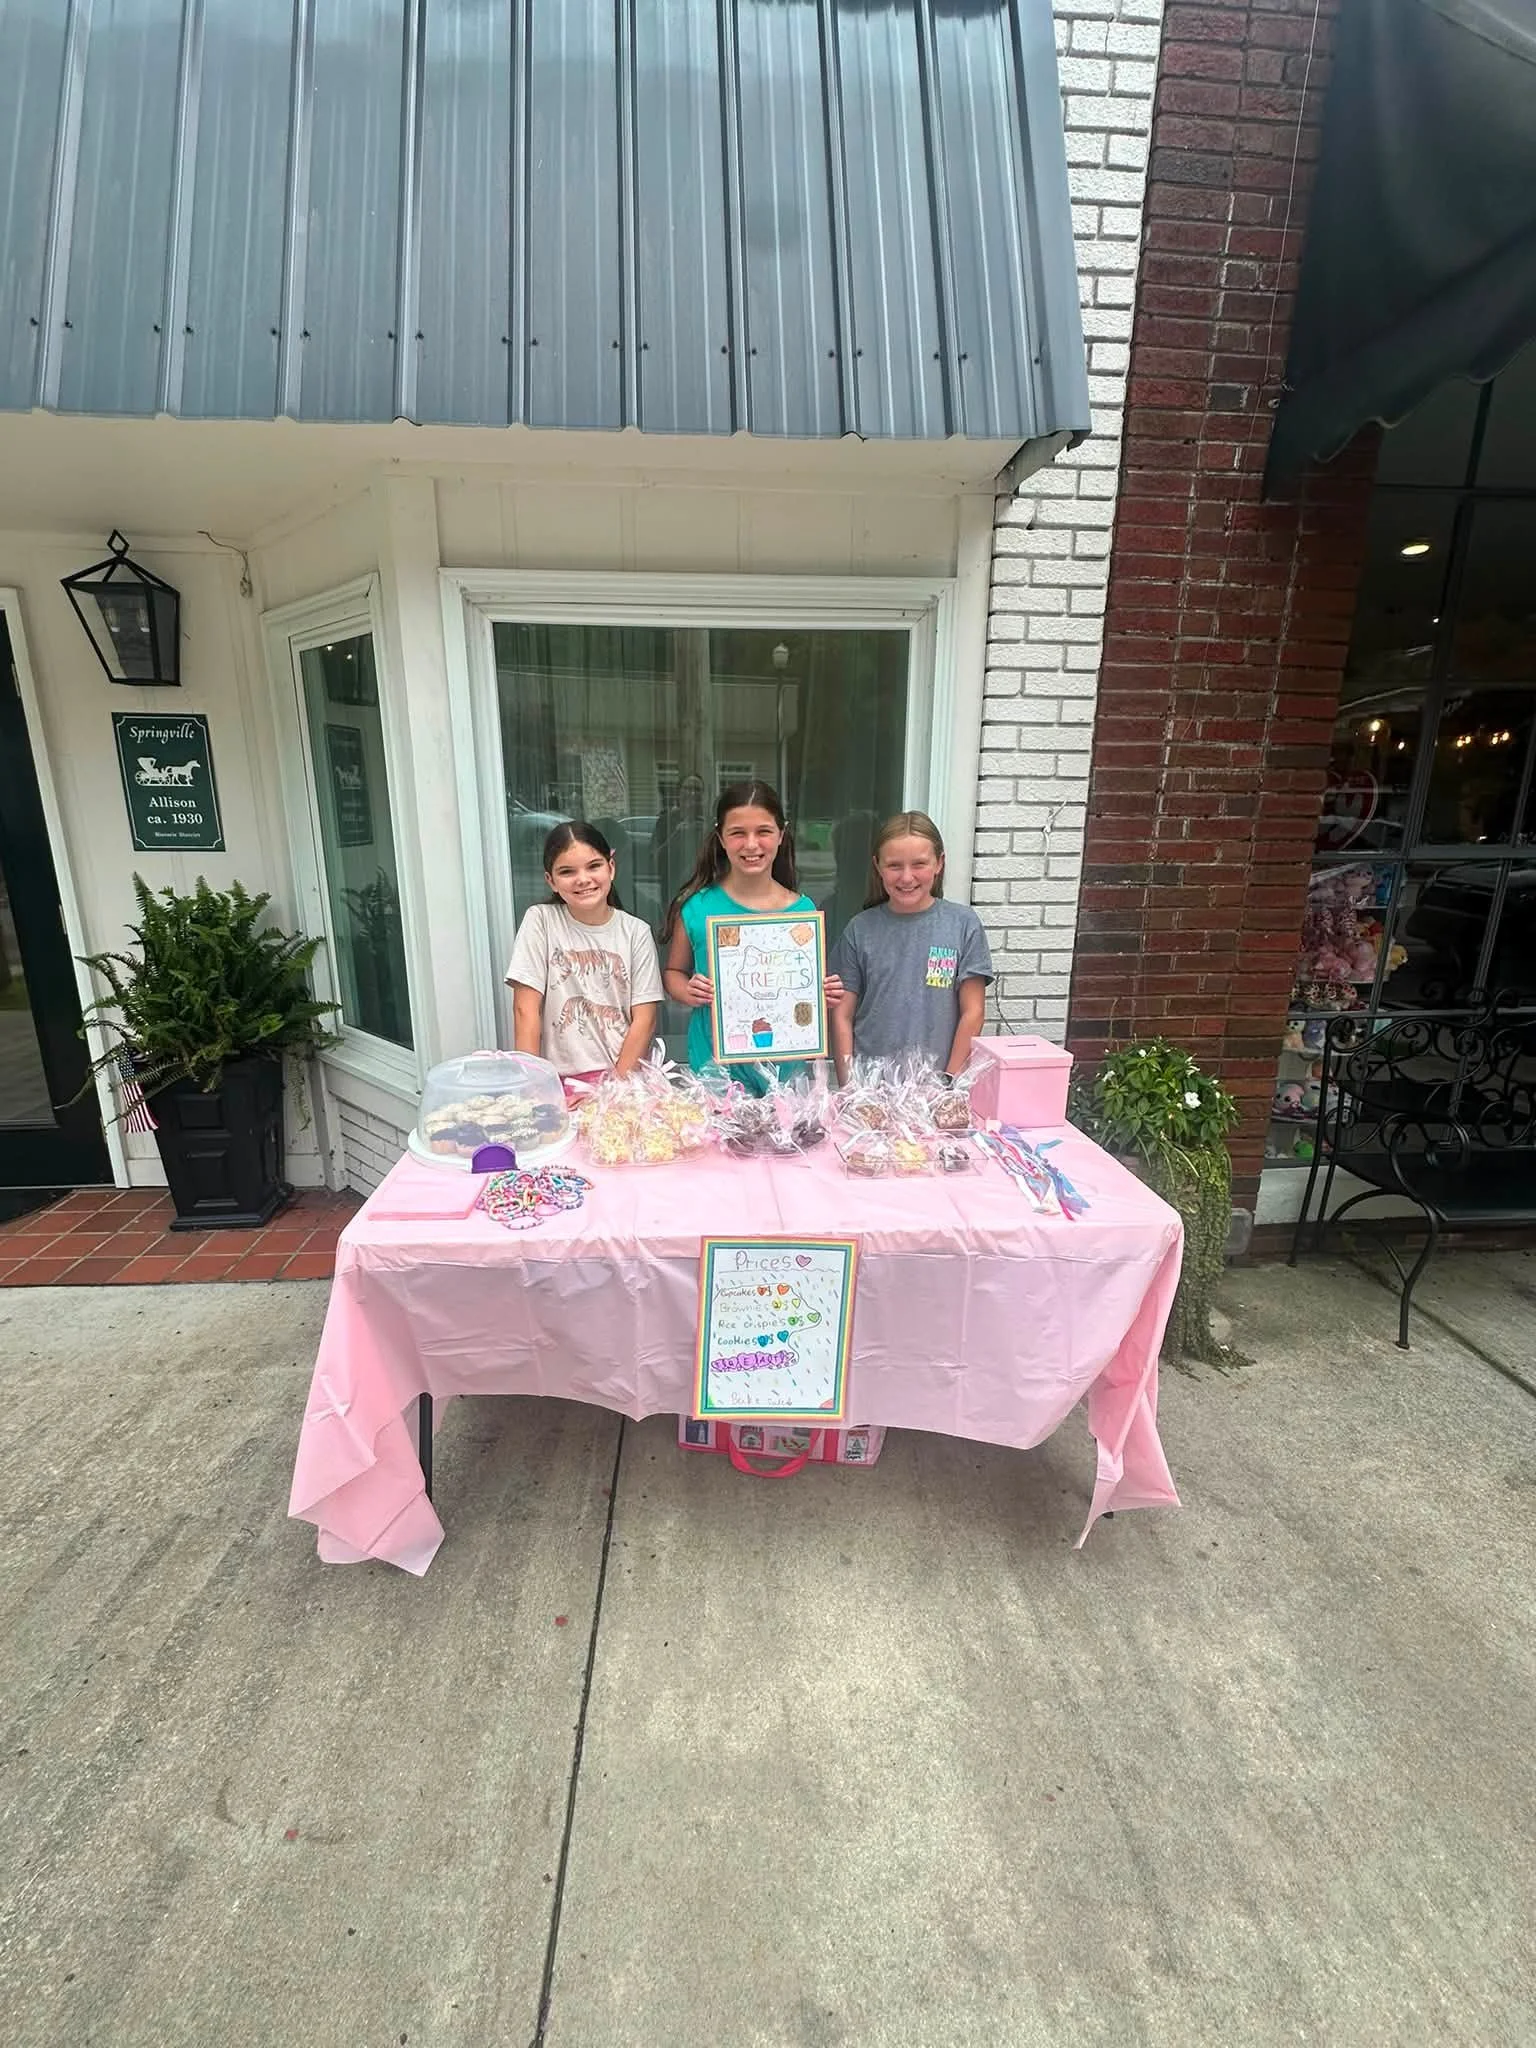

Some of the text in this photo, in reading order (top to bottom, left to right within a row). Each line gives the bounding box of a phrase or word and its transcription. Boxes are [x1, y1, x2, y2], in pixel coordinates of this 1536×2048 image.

[129, 722, 195, 744] Springville
[149, 797, 197, 808] Allison
[147, 813, 203, 824] ca. 1930
[740, 968, 811, 988] TREATS
[736, 1250, 792, 1270] Prices
